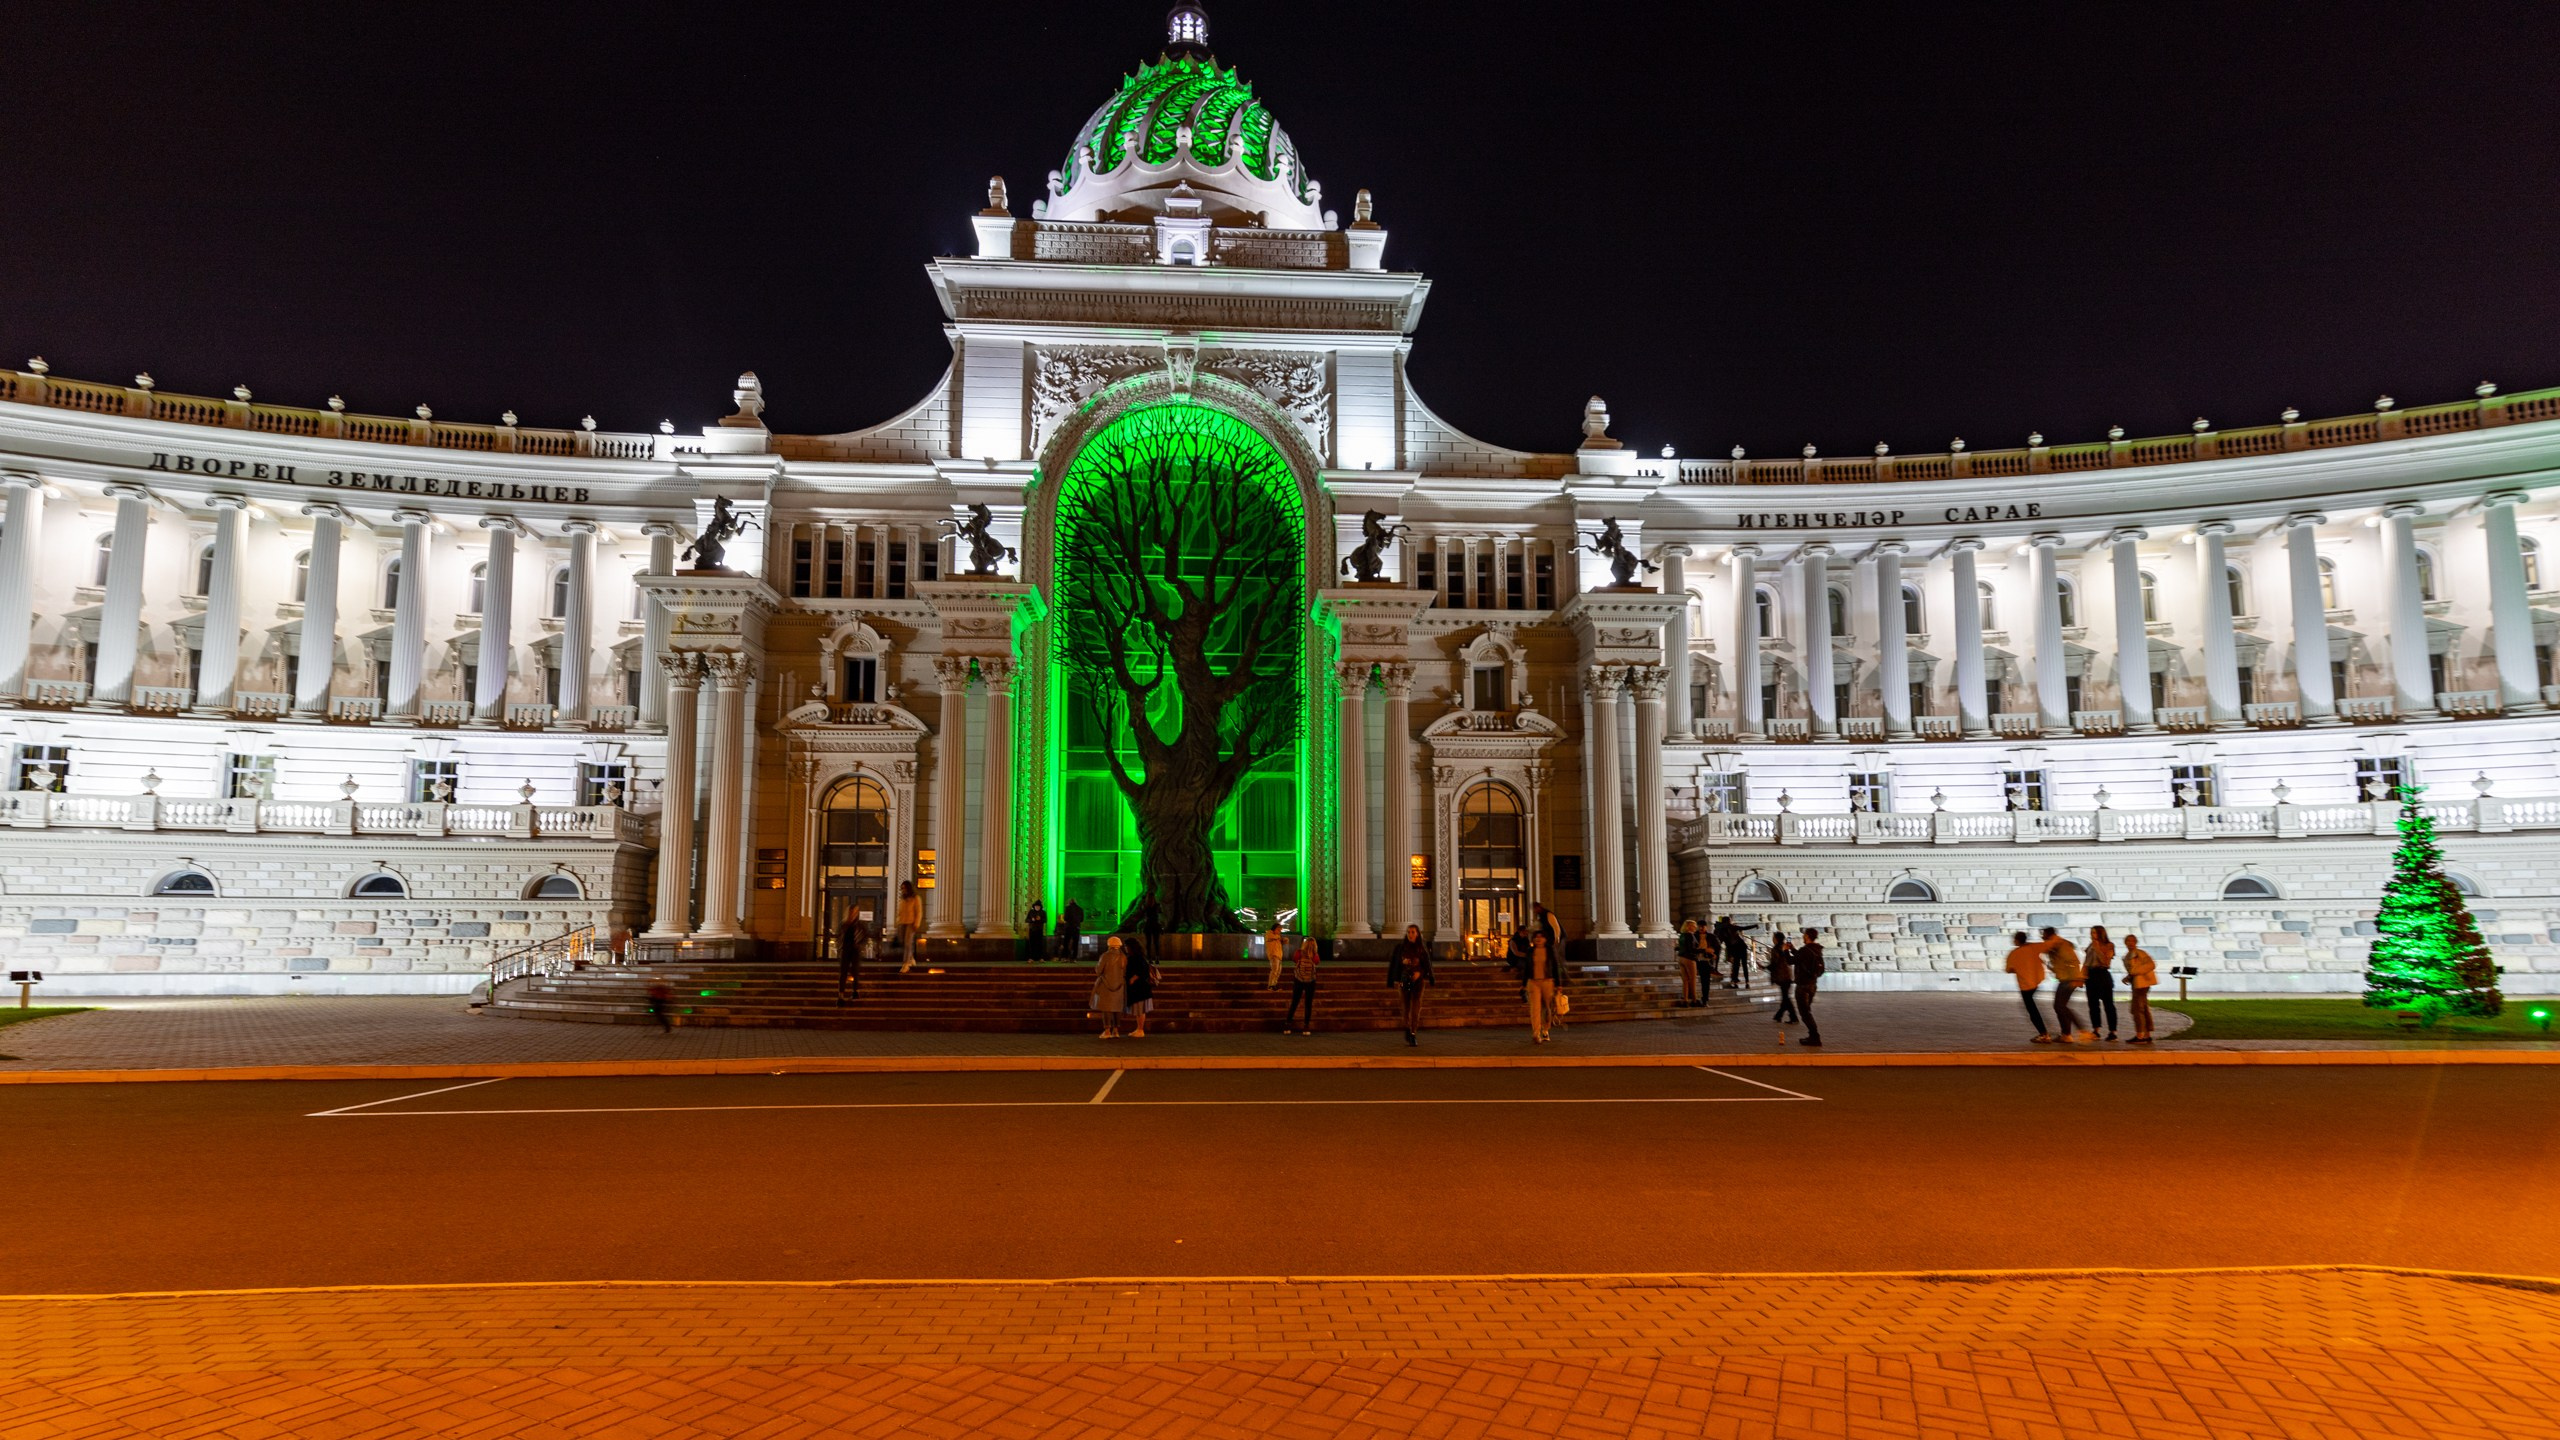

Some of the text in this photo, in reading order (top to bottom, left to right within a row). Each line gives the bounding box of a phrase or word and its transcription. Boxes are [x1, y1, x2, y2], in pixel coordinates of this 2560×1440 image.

[148, 453, 590, 502] ДВОРЕЦ ЗЕМЛЕДЕЛЬЦЕВ
[1737, 503, 2042, 528] ИГЕНЧЕЛӘР САРАЕ
